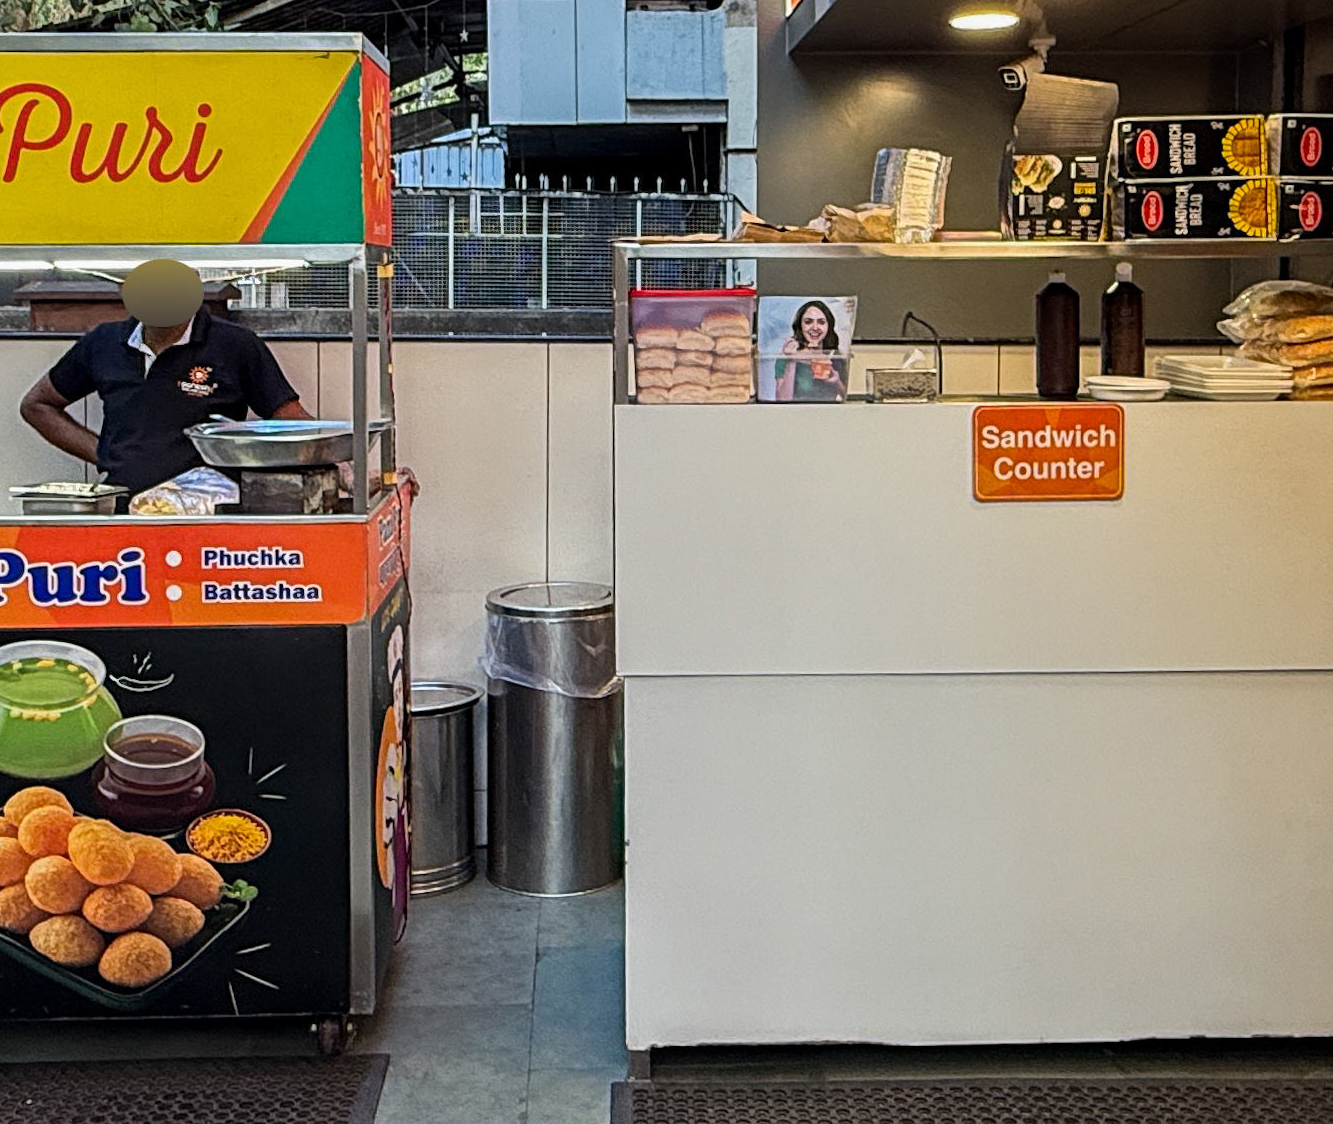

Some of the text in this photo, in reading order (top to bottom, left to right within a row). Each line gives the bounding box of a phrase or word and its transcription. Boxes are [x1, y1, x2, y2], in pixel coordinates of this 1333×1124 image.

[1168, 123, 1184, 175] SANDWICH
[1183, 132, 1197, 166] BREAD
[1174, 184, 1190, 236] SANDWICH
[1189, 193, 1204, 227] BREAD
[981, 424, 1116, 449] Sandwich
[993, 456, 1105, 481] Counter
[202, 547, 303, 569] Phuchka
[202, 582, 322, 603] Battashaa
